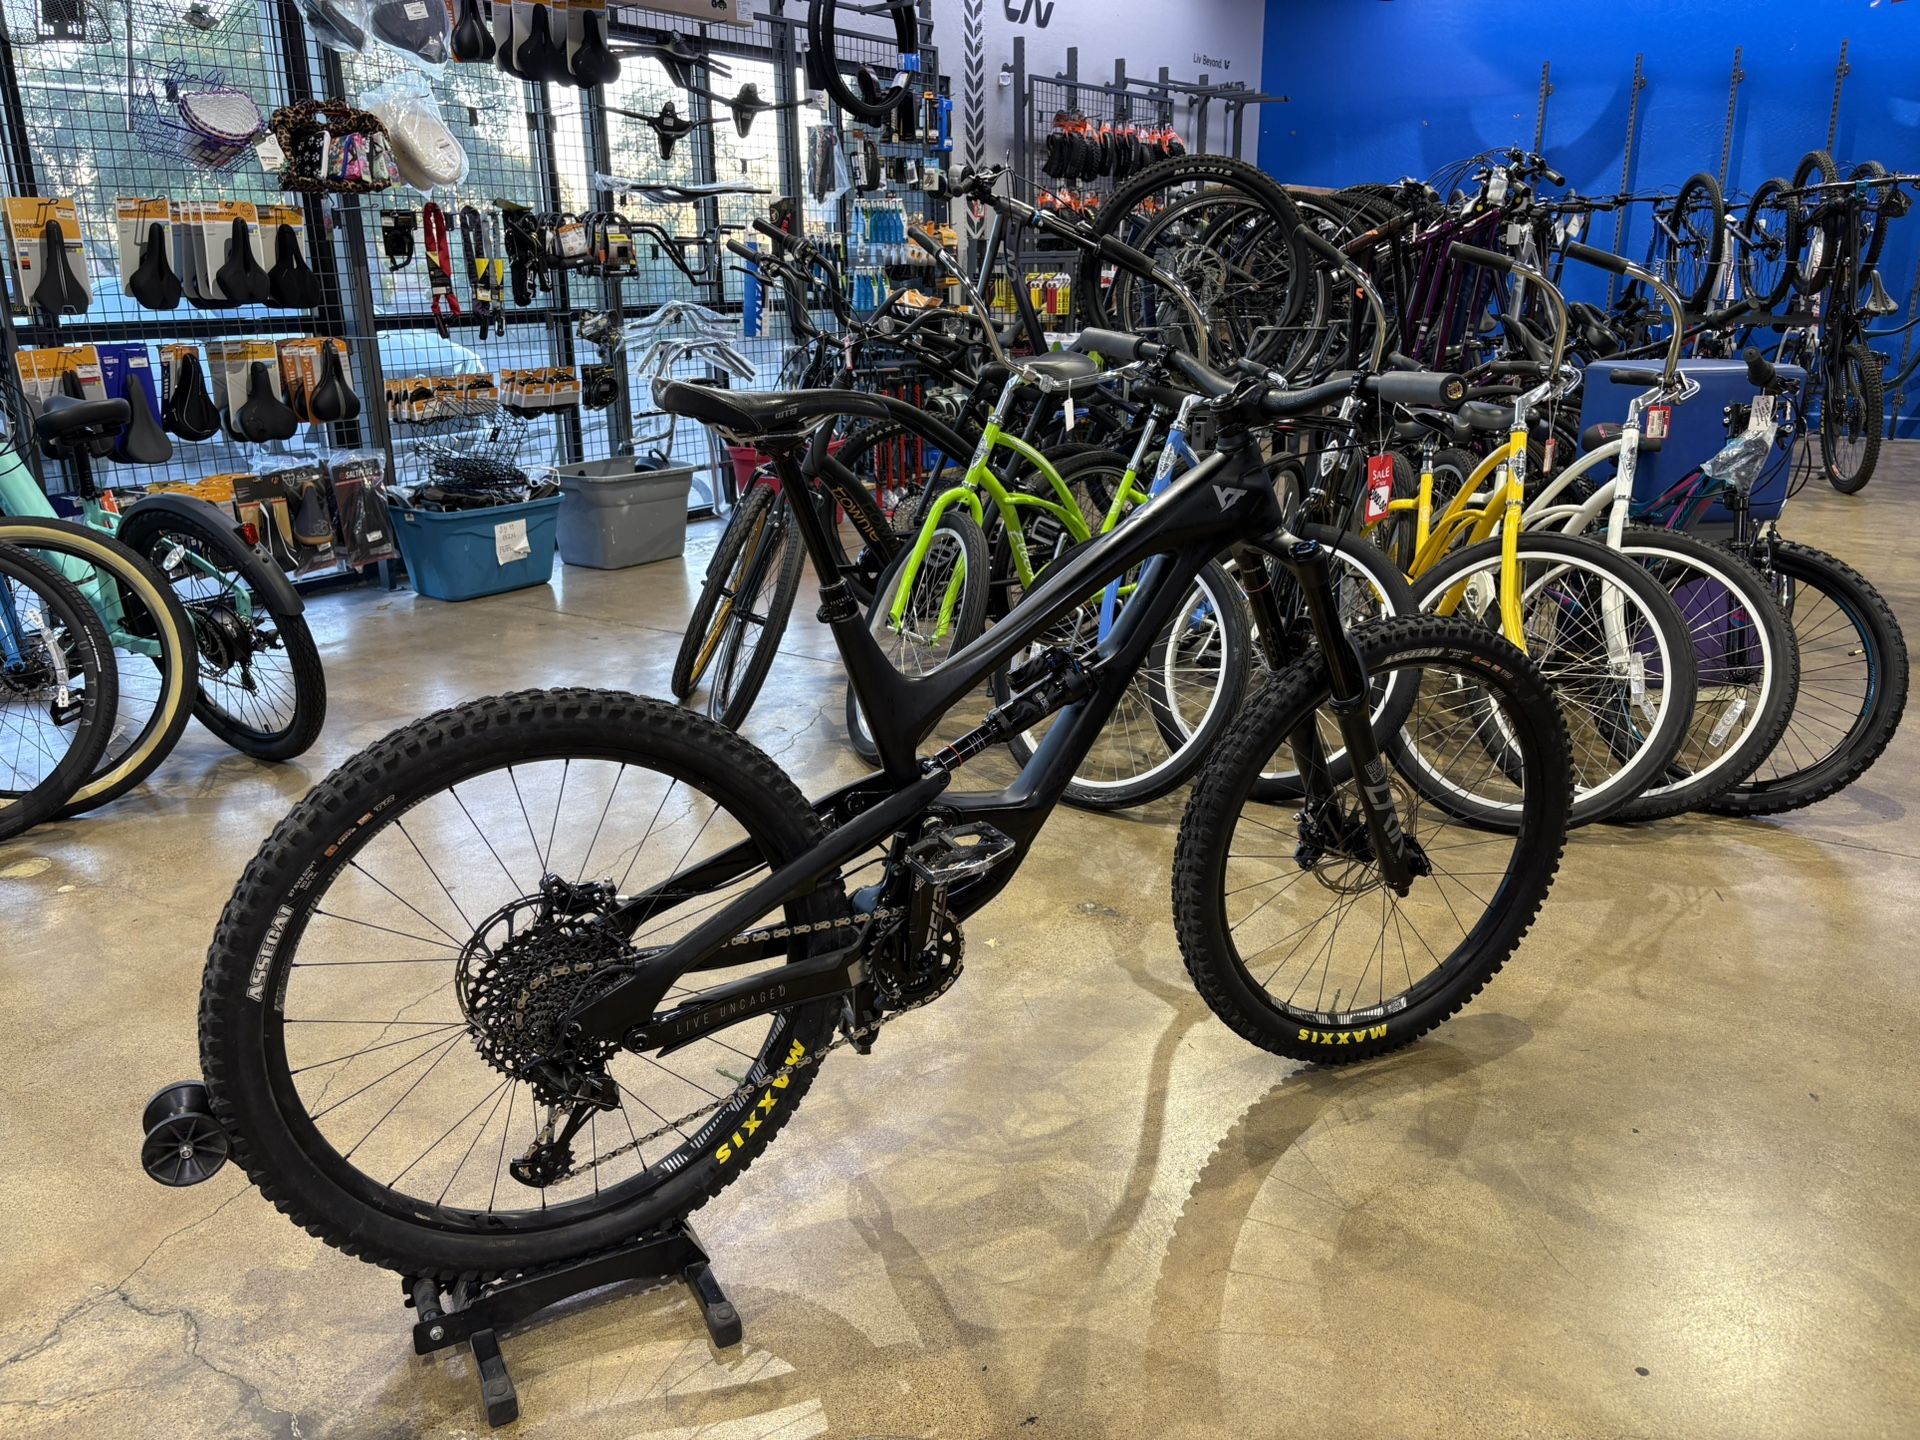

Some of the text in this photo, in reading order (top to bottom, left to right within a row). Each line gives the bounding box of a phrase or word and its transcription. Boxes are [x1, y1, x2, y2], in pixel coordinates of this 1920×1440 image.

[1173, 165, 1233, 176] MAXXIS
[1372, 466, 1390, 481] SALE
[247, 904, 294, 1002] ASSEGAI
[676, 984, 786, 1036] LIVE UNCAGED
[1297, 1023, 1388, 1045] MAXXIS
[715, 1038, 806, 1165] MAXXIS
